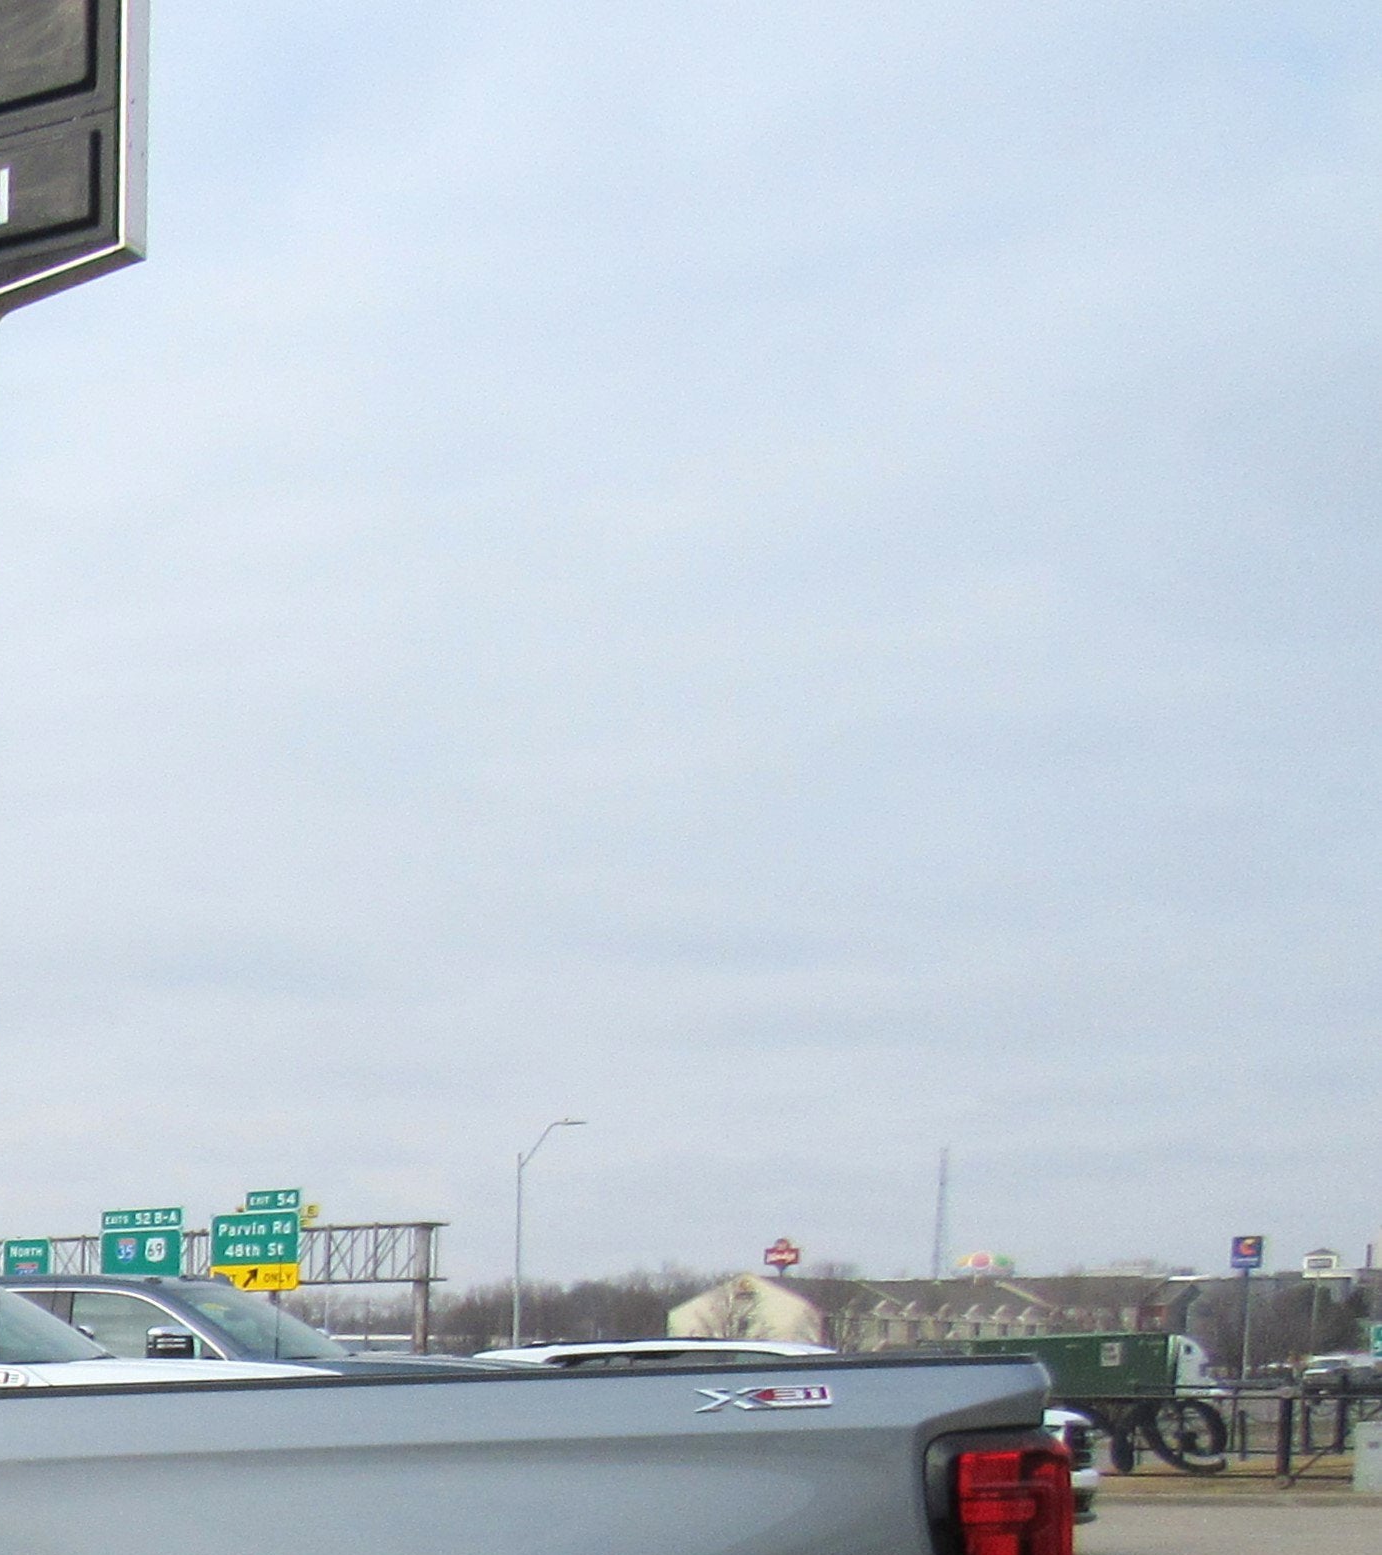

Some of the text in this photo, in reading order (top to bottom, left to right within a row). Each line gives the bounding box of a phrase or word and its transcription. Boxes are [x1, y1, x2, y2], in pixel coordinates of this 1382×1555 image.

[276, 1192, 296, 1207] 54
[135, 1211, 152, 1226] 52
[218, 1220, 292, 1237] Parvin Rd
[117, 1242, 163, 1260] 35 69
[224, 1242, 284, 1258] 48th St
[263, 1271, 293, 1283] ONLY
